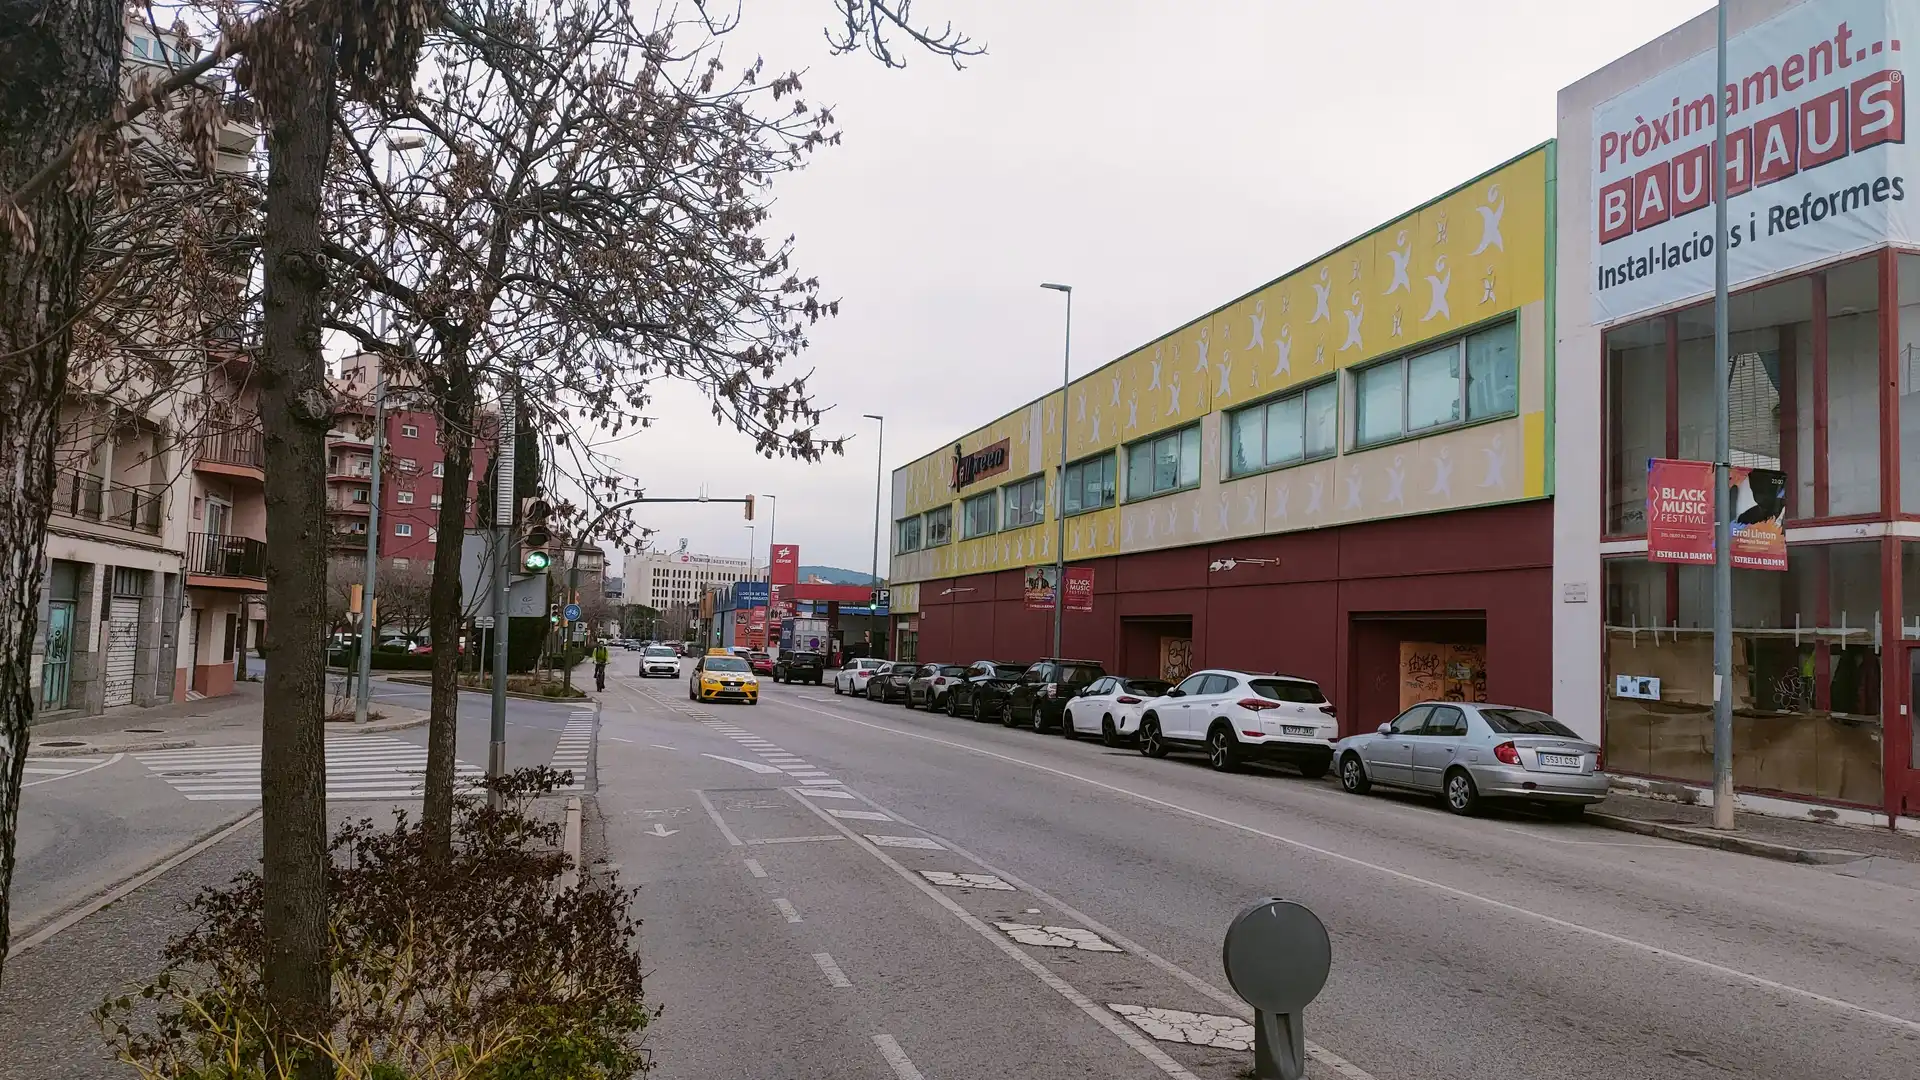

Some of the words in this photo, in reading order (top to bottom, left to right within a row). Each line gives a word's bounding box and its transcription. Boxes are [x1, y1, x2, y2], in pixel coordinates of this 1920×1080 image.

[1600, 21, 1901, 173] Pròximament...
[1602, 76, 1897, 235] BAUHAUS
[1598, 224, 1742, 291] Instal·lacios
[1750, 211, 1756, 242] i
[1768, 176, 1905, 236] Reformes
[1662, 487, 1706, 501] BLACK
[1662, 501, 1706, 514] MUSIC
[1661, 513, 1707, 524] FESTIVAL
[1732, 528, 1750, 538] Errol
[1751, 529, 1776, 540] Linton
[1656, 550, 1688, 559] ESTRELLA
[1689, 552, 1713, 560] DAMM
[1762, 558, 1785, 566] DAMM
[880, 590, 889, 601] P
